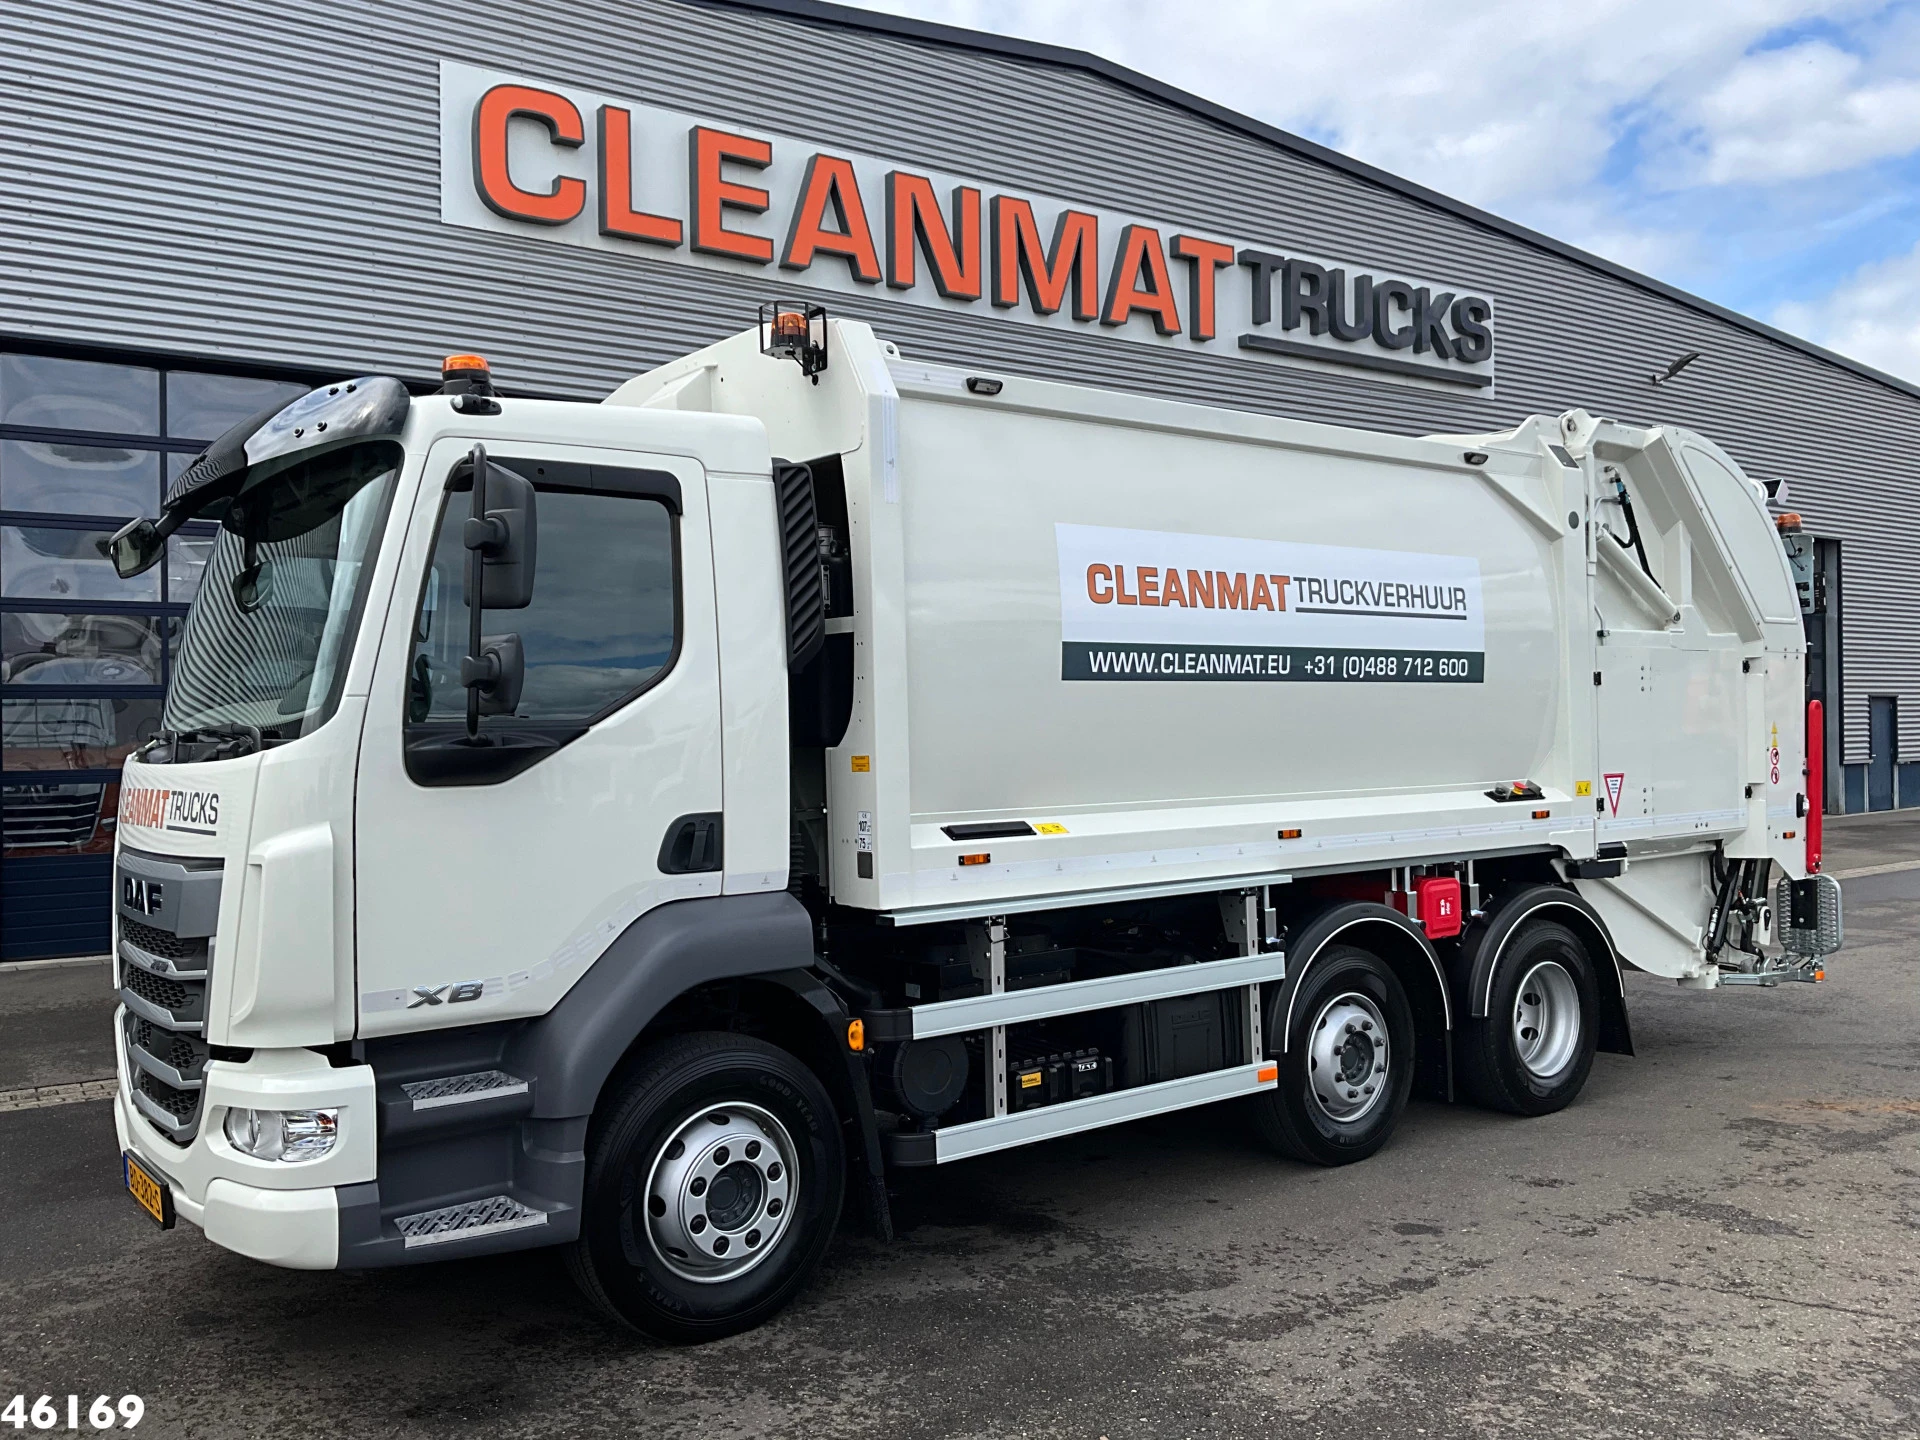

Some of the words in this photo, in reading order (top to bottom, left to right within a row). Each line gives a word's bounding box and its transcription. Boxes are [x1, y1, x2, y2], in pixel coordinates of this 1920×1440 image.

[472, 83, 1235, 341] CLEANMAT
[1237, 248, 1493, 363] TRUCKS
[1086, 563, 1291, 612] CLEANMAT
[1293, 576, 1467, 611] TRUCKVERHUUR
[1089, 650, 1291, 676] WWW.CLEANMAT.EU
[1304, 655, 1335, 676] +31
[1342, 655, 1397, 679] (0)488
[1403, 657, 1433, 677] 712
[1438, 657, 1469, 678] 600
[119, 788, 170, 829] LEANMAT
[169, 791, 219, 825] TRUCKS
[859, 838, 866, 849] 75
[124, 876, 163, 916] DAF
[407, 979, 483, 1008] XB
